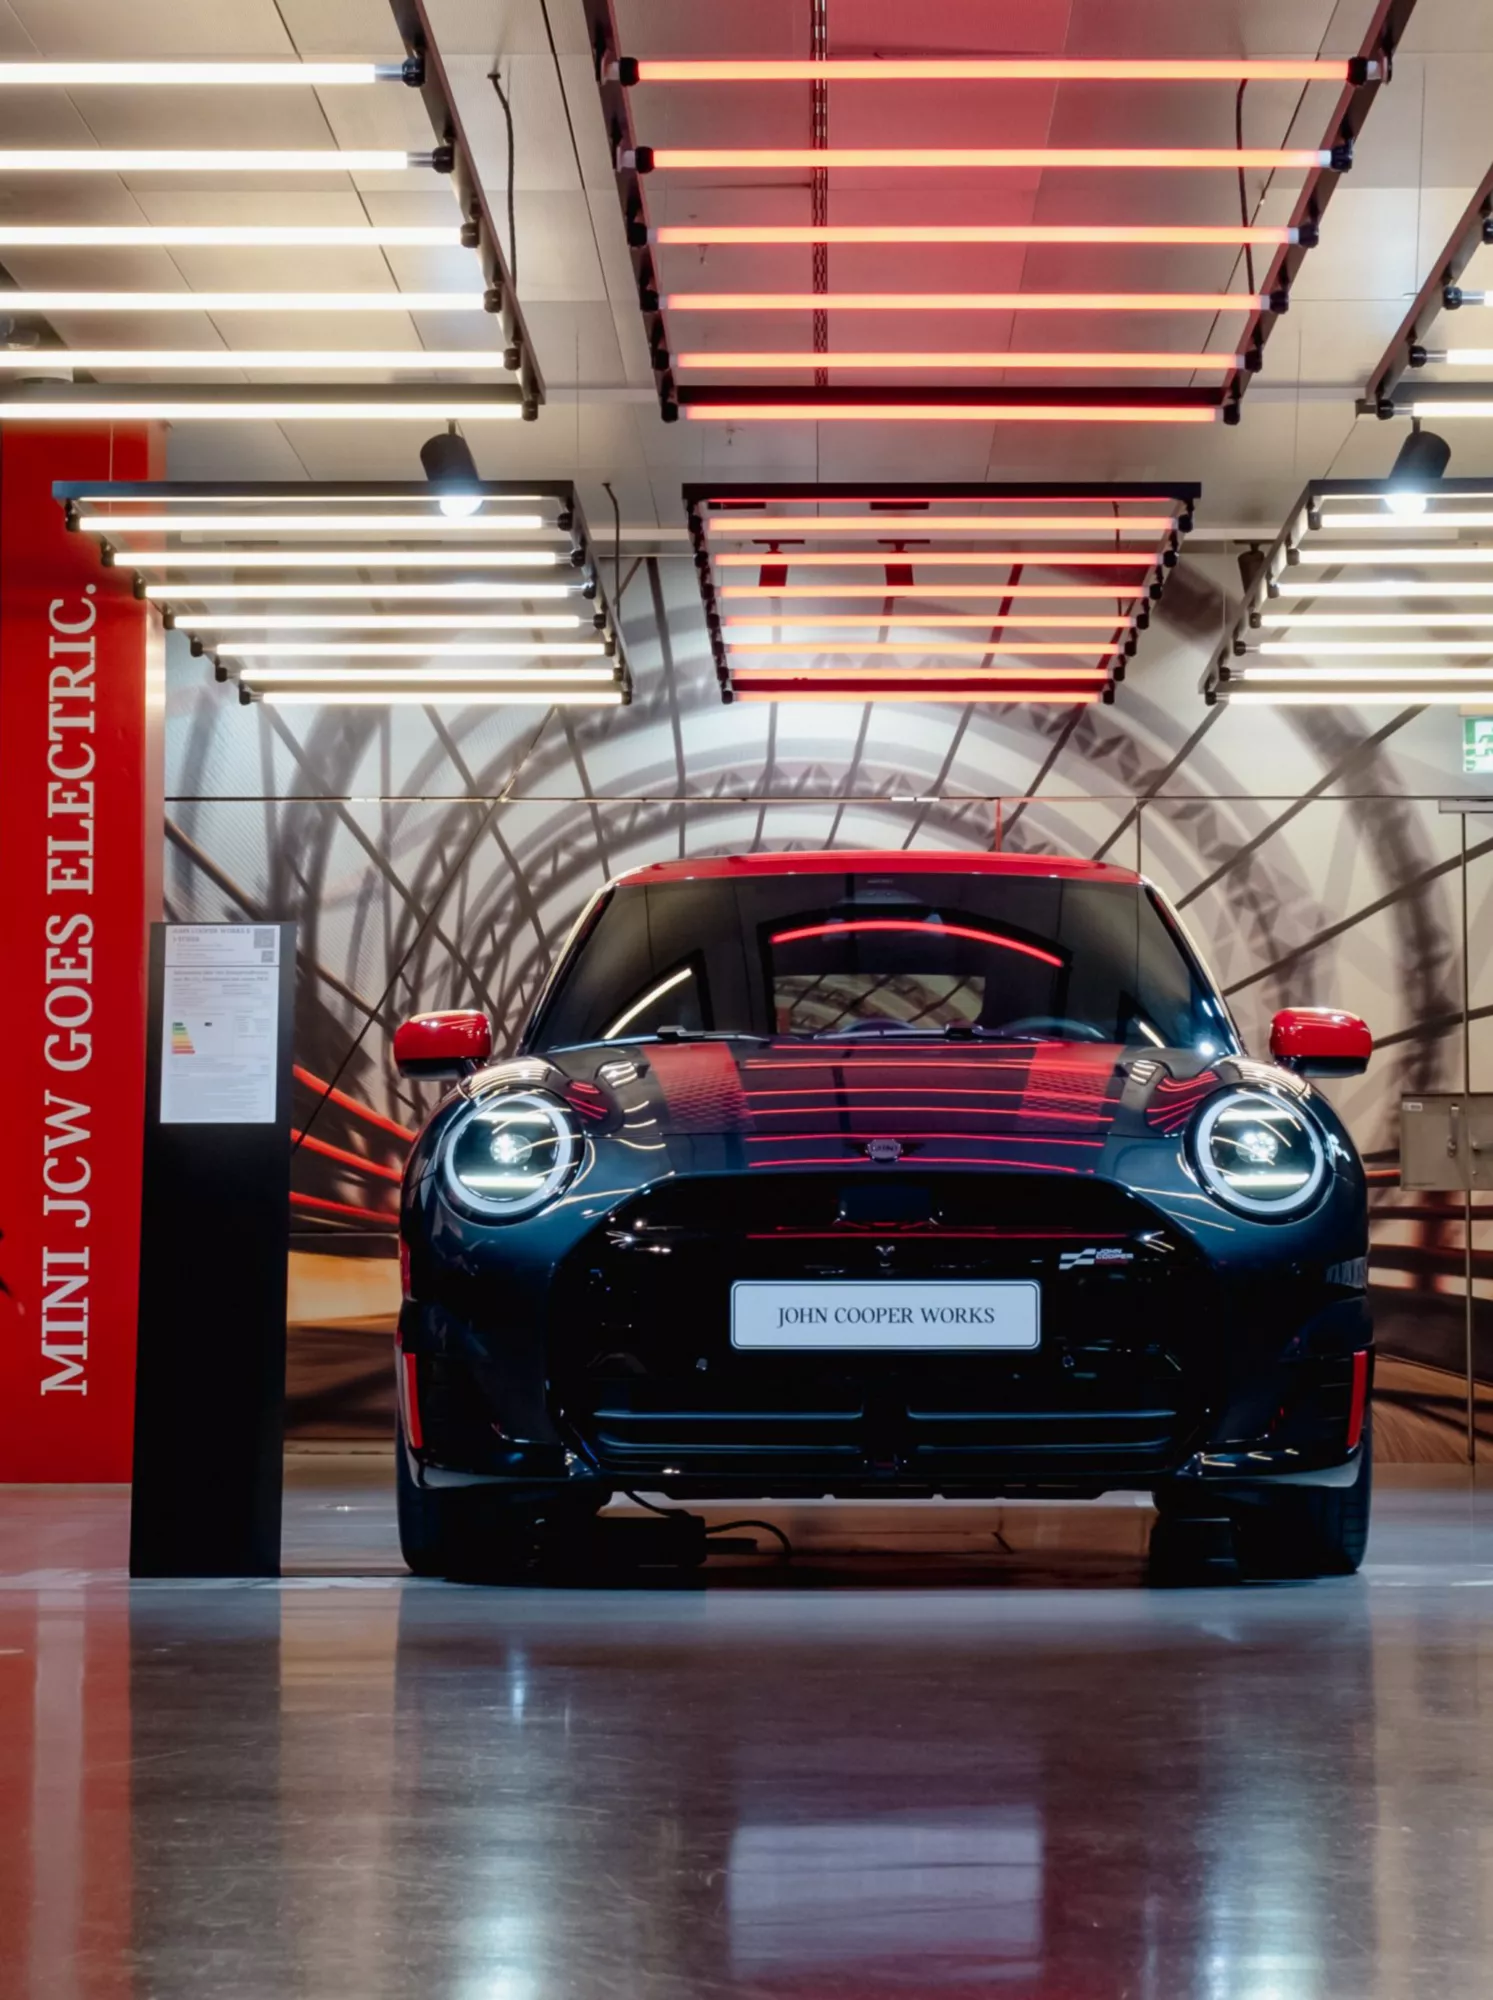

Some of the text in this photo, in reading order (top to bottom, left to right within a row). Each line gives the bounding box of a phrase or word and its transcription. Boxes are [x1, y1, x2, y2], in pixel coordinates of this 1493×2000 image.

[40, 583, 97, 1396] MINI JCW GOES ELECTRIC.
[777, 1307, 995, 1328] JOHN COOPER WORKS
